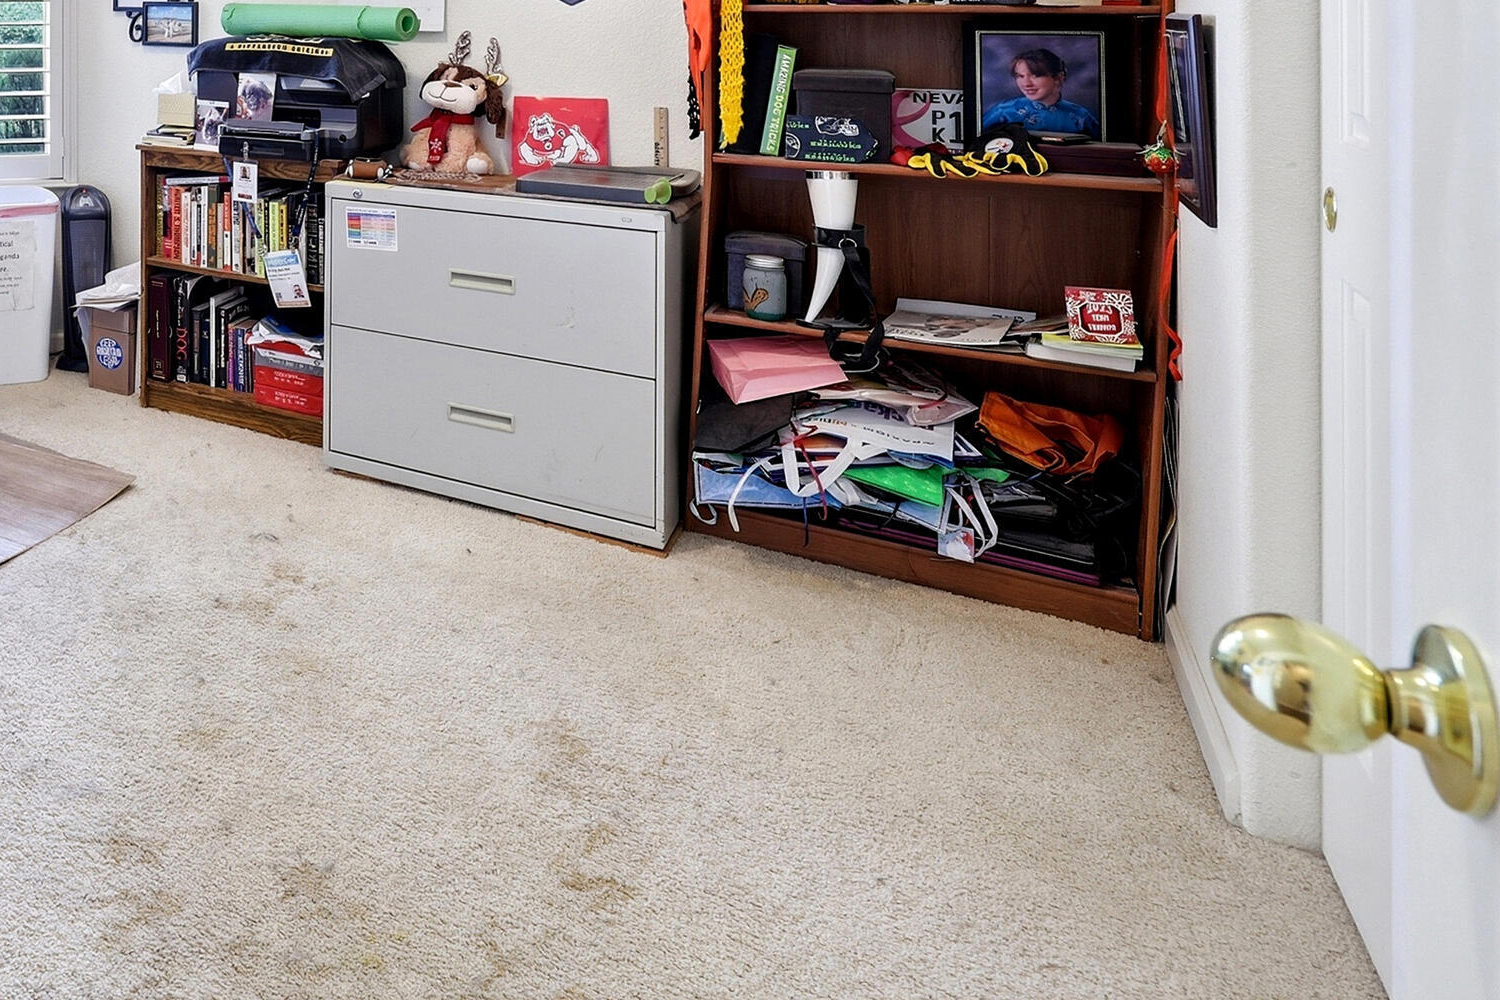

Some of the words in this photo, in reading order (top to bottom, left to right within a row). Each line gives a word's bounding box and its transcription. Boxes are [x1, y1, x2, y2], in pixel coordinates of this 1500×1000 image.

[776, 53, 792, 94] AMAZING
[772, 95, 785, 115] DOG
[913, 92, 964, 104] NEVA
[766, 117, 781, 152] TRICKS
[176, 328, 188, 360] DOG
